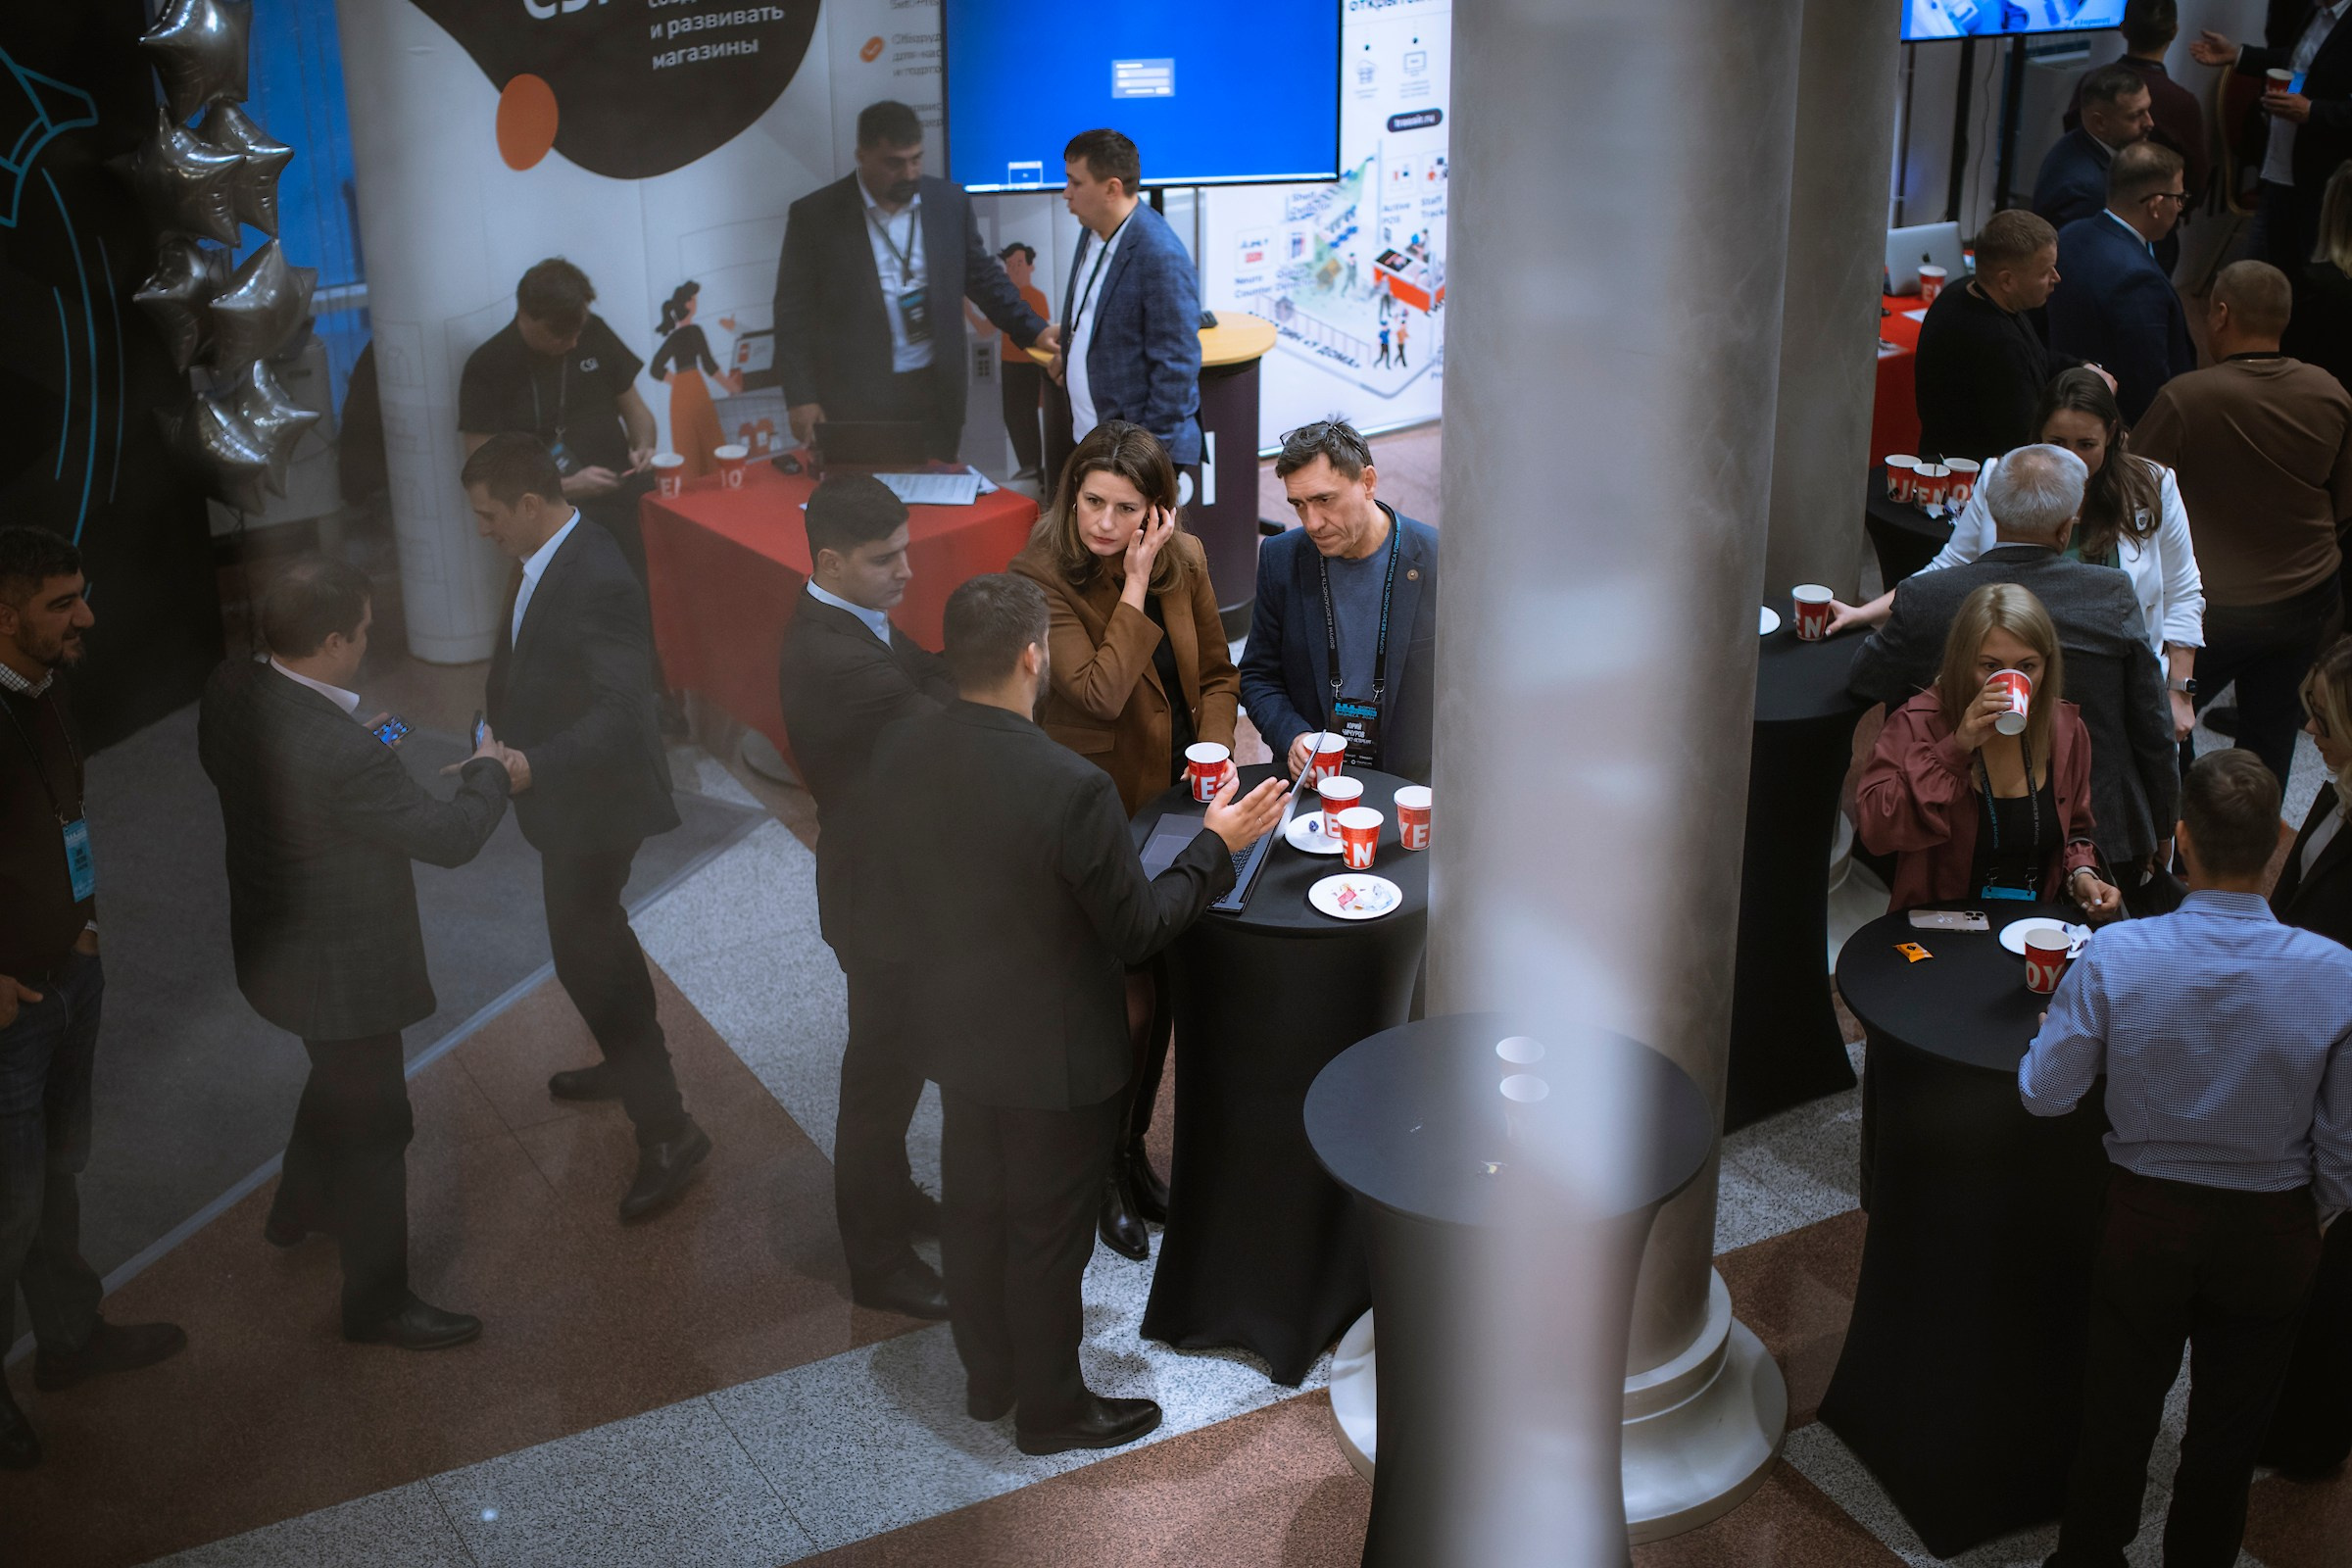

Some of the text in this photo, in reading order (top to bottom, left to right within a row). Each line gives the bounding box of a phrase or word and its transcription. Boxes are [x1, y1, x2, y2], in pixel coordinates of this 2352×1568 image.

[650, 6, 784, 39] и развивать
[653, 39, 760, 70] магазины
[1381, 582, 1392, 631] БЕЗОПАСНОСТЬ
[1387, 553, 1398, 582] БИЗНЕСА
[2026, 960, 2064, 991] OY
